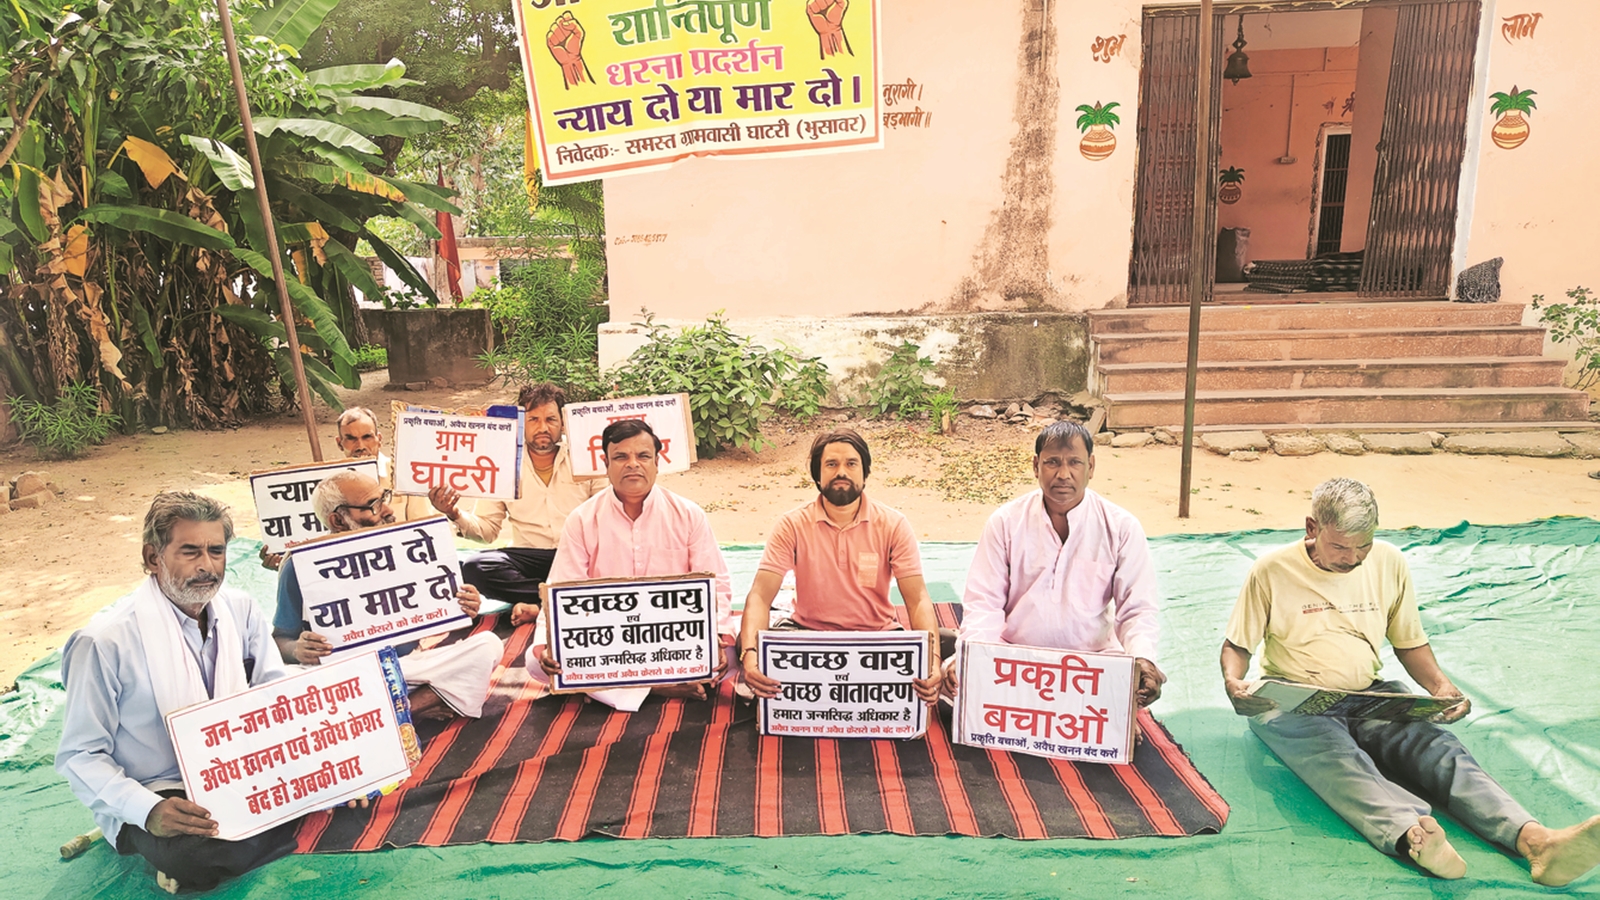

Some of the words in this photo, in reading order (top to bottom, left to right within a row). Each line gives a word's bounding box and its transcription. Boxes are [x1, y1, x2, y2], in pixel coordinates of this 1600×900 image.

[1501, 12, 1544, 46] लाभ
[606, 53, 683, 86] धरना
[689, 40, 783, 75] प्रदर्शन
[553, 99, 633, 132] न्याय
[642, 83, 680, 122] दो
[686, 87, 722, 114] या
[732, 82, 795, 112] मार
[625, 134, 677, 154] समस्त
[680, 122, 741, 146] ग्रामवासी
[746, 118, 790, 140] घाटरी
[796, 114, 866, 140] (भुसावर)
[403, 416, 422, 428] प्रकृति
[572, 405, 591, 417] प्रकृति
[436, 431, 477, 452] ग्राम
[410, 455, 499, 494] घांटरी
[262, 516, 292, 537] या
[313, 545, 396, 580] न्याय
[401, 529, 438, 565] दो
[309, 598, 353, 628] या
[359, 582, 418, 616] मार
[425, 565, 459, 601] दो
[560, 592, 639, 615] स्वच्छ
[648, 588, 703, 614] वायु
[343, 630, 365, 642] अवैध
[396, 617, 409, 628] को
[410, 614, 424, 624] बंद
[626, 613, 641, 623] एवं
[561, 625, 614, 649] स्वच्छ
[620, 620, 705, 645] बातावरण
[566, 656, 596, 668] हमारा
[600, 650, 647, 666] जन्मसिद्ध
[650, 647, 692, 662] अधिकार
[695, 644, 703, 660] है
[770, 650, 849, 670] स्वच्छ
[858, 650, 914, 676] वायु
[565, 671, 583, 681] अवैध
[585, 673, 605, 681] खनन
[607, 670, 618, 679] एवं
[621, 668, 638, 678] अवैध
[664, 665, 675, 675] को
[835, 672, 850, 681] एवं
[993, 655, 1104, 701] प्रकृति
[828, 681, 914, 703] बातावरण
[200, 707, 271, 748] जन-जन
[270, 695, 294, 724] की
[292, 685, 321, 716] यही
[322, 676, 363, 715] पुकार
[773, 708, 803, 721] हमारा
[806, 708, 853, 722] जन्मसिद्ध
[857, 708, 900, 722] अधिकार
[903, 707, 911, 721] है
[983, 704, 1109, 745] बचाओं
[771, 723, 789, 732] अवैध
[791, 725, 811, 733] खनन
[813, 725, 824, 733] एवं
[826, 724, 844, 733] अवैध
[870, 725, 880, 733] को
[200, 757, 242, 793] अवैध
[242, 744, 286, 776] खनन
[285, 728, 311, 760] एवं
[310, 720, 348, 753] अवैध
[350, 708, 385, 740] क्रेशर
[970, 732, 995, 746] प्रकृति
[1032, 740, 1055, 753] अवैध
[1057, 744, 1082, 755] खनन
[1083, 745, 1098, 757] बंद
[246, 784, 271, 815] बंद
[270, 777, 290, 808] हो
[293, 760, 338, 800] अबकी
[338, 755, 363, 783] बार
